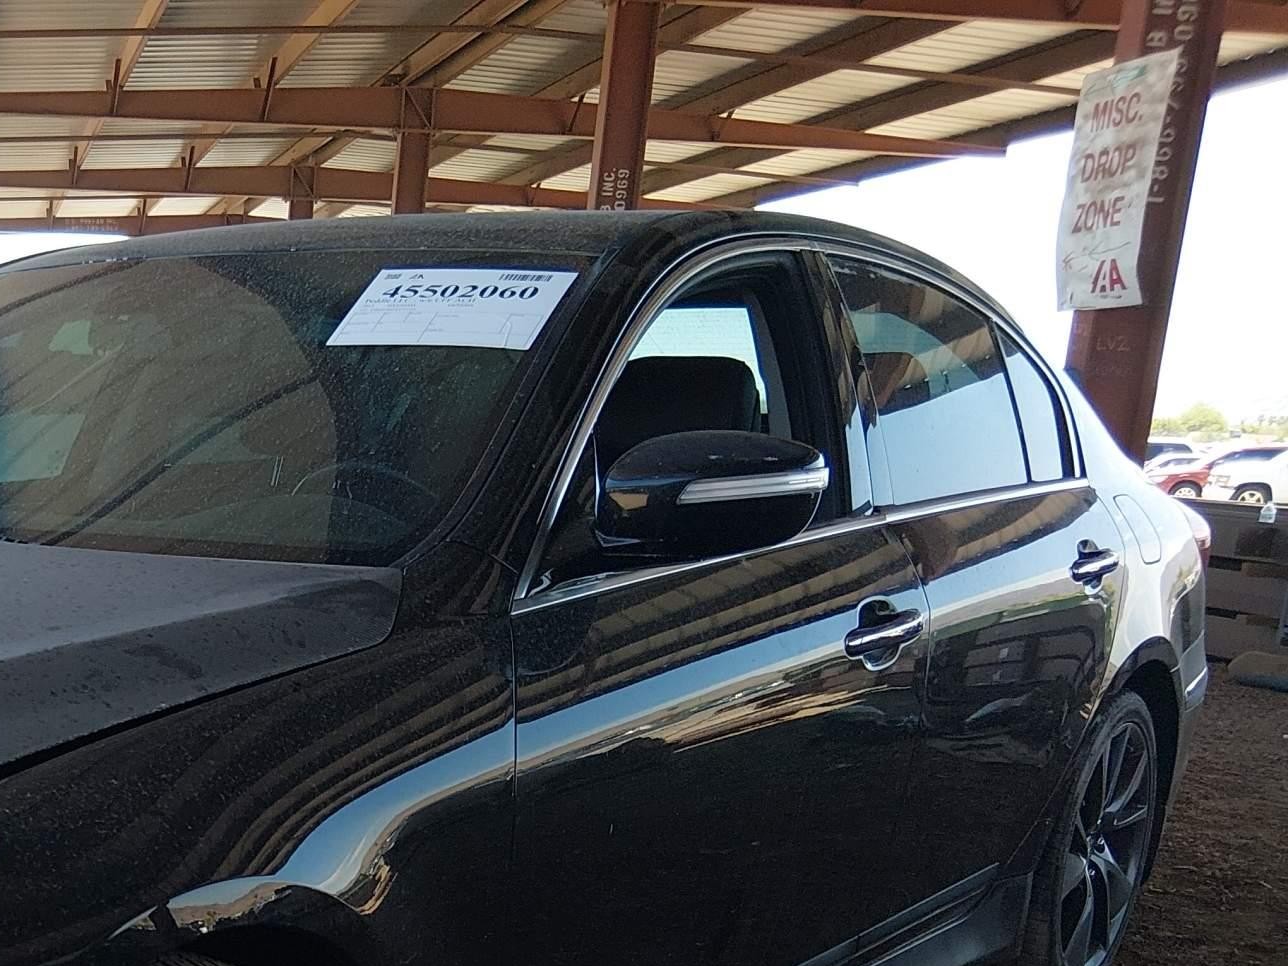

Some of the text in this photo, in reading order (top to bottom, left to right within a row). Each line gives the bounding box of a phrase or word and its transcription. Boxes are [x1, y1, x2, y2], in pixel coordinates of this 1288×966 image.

[1090, 92, 1143, 133] MISC.
[1080, 143, 1136, 183] DROP
[1071, 195, 1125, 234] ZONE
[382, 284, 540, 300] 45502060
